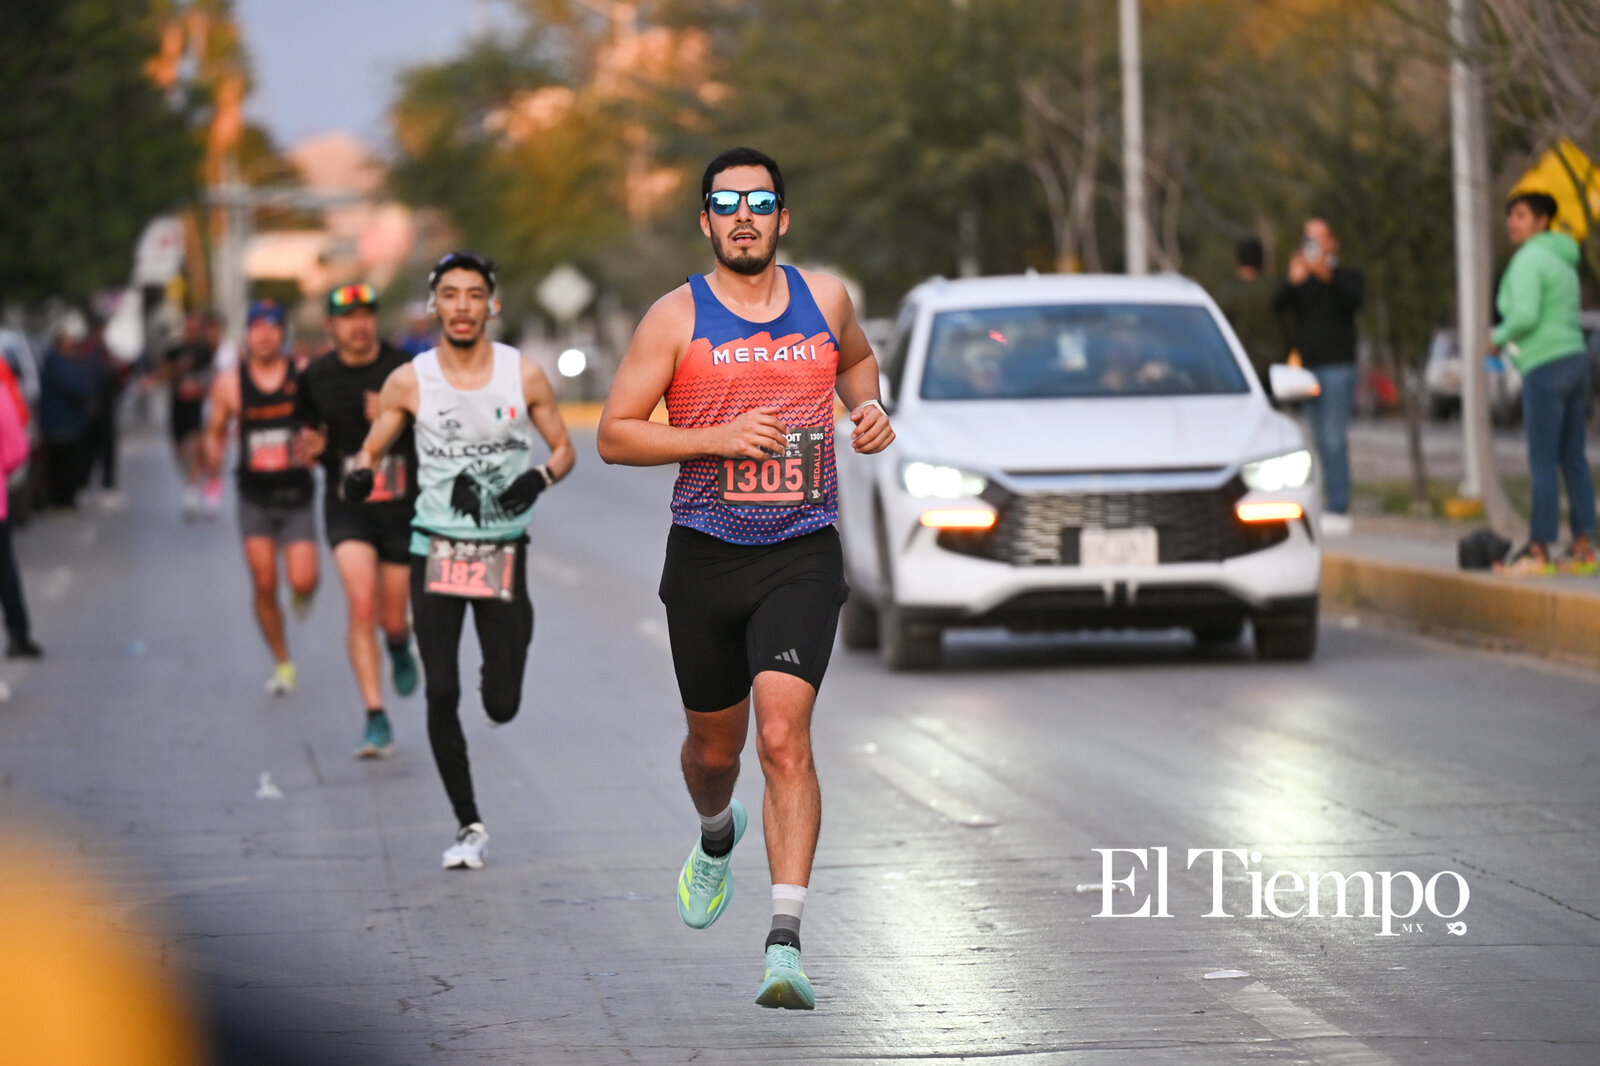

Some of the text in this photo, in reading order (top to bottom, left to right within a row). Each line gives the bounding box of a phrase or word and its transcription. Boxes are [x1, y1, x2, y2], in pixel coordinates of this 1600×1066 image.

[713, 344, 816, 365] MERAKI
[810, 433, 823, 441] 1305
[723, 458, 803, 492] 1305
[813, 444, 821, 488] MEDALLA
[441, 559, 487, 587] 182
